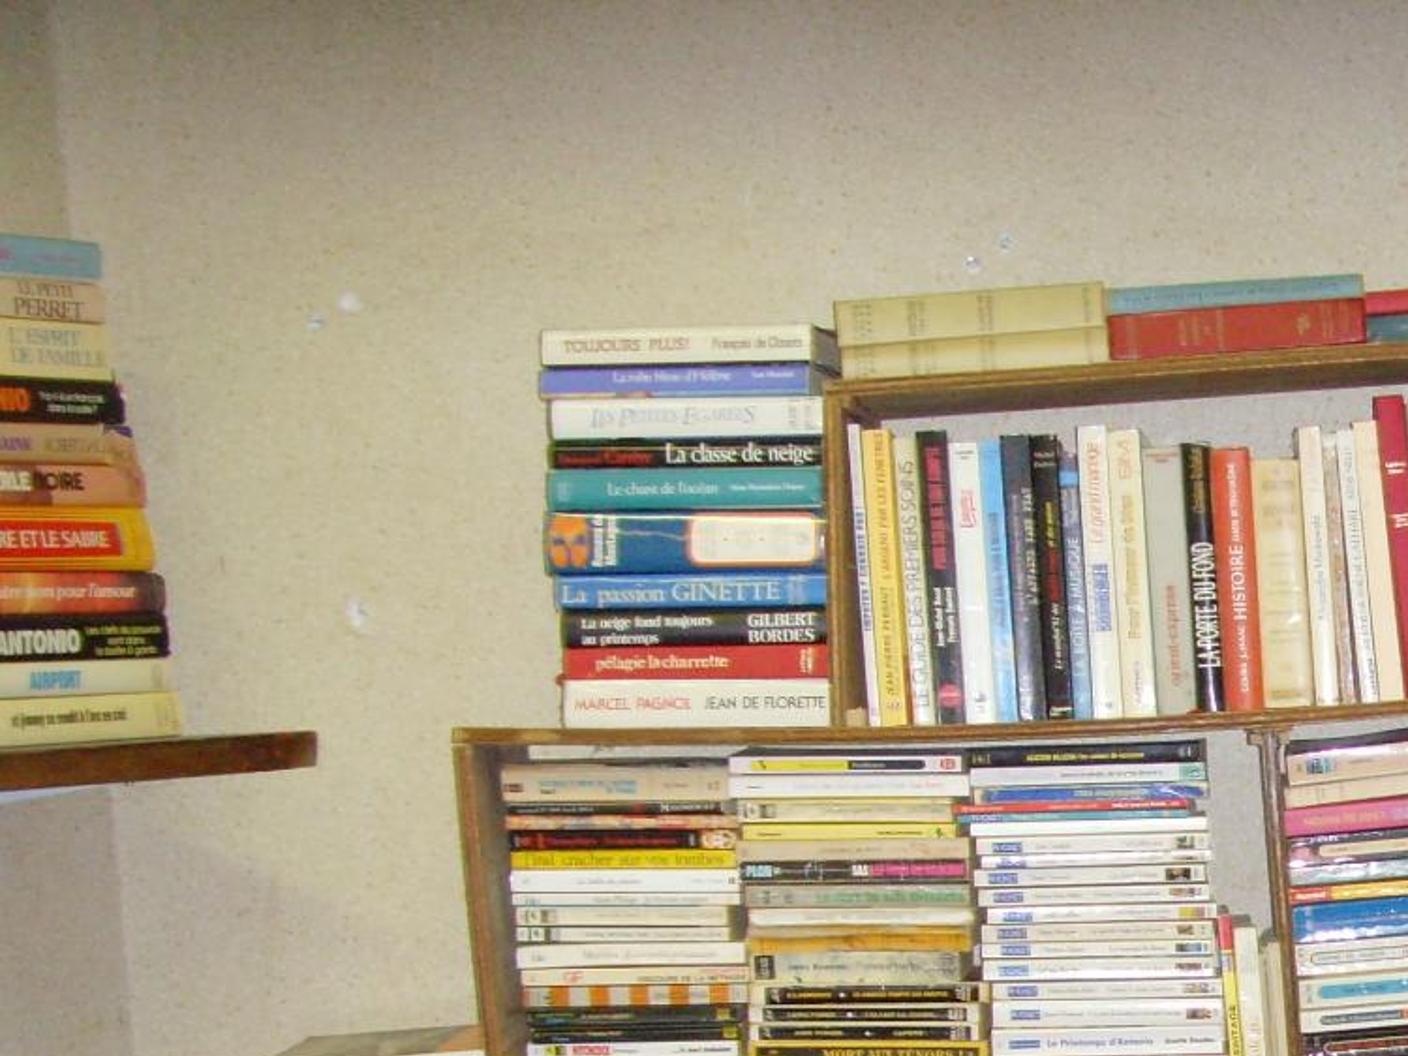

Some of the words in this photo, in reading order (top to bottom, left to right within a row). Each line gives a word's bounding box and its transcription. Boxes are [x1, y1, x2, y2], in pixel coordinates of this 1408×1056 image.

[14, 297, 84, 320] PERRET
[565, 338, 641, 354] TOUJOURS
[666, 443, 684, 464] La
[686, 442, 738, 464] classe
[742, 442, 763, 462] de
[766, 443, 812, 467] neige
[899, 462, 915, 510] SOINS
[20, 531, 40, 549] ET
[42, 531, 60, 548] LE
[903, 515, 921, 591] PREMIERS
[1189, 542, 1211, 578] FOND
[1192, 581, 1213, 601] DU
[1229, 545, 1248, 620] HISTOIRE
[562, 584, 587, 604] La
[597, 585, 665, 607] passion
[671, 581, 782, 602] GINETTE
[747, 612, 815, 628] GILBERT
[909, 595, 924, 627] DES
[600, 615, 631, 632] neige
[634, 614, 661, 630] fond
[665, 613, 713, 632] toujours
[1195, 605, 1218, 648] PORTE
[600, 631, 660, 648] printemps
[748, 628, 815, 644] BORDES
[595, 655, 647, 673] pélagie
[662, 654, 730, 670] charrette
[1198, 650, 1220, 667] LA
[575, 696, 630, 711] MARCEL
[636, 695, 691, 711] PAGNOL
[705, 695, 738, 710] JEAN
[742, 694, 763, 710] DE
[765, 693, 826, 710] FLORETTE
